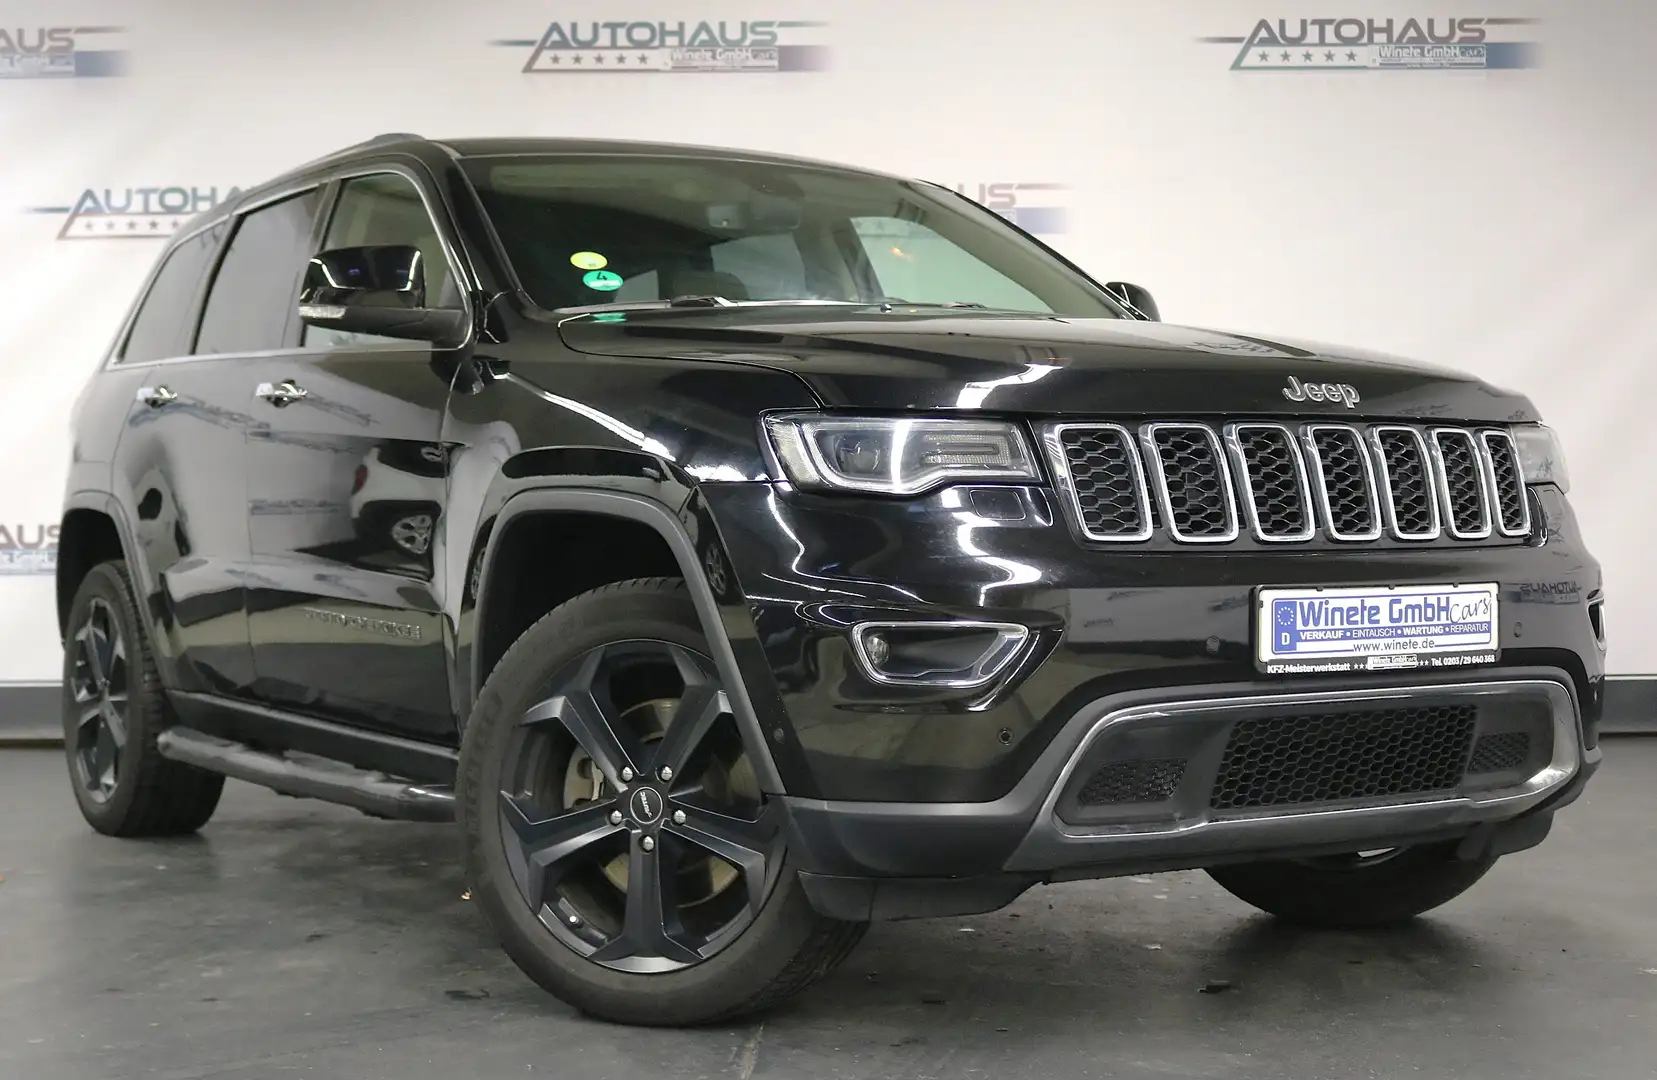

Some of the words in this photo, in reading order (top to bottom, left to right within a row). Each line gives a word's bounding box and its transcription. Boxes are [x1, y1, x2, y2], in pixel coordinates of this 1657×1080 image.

[541, 21, 778, 47] AUTOHAUS
[1247, 18, 1486, 44] AUTOHAUS
[1424, 45, 1460, 58] GmbH
[596, 271, 608, 281] 4
[1281, 375, 1361, 408] Jeep
[1388, 597, 1450, 624] GmbH
[1281, 632, 1290, 646] D
[1300, 630, 1344, 641] VERKAUF
[1352, 627, 1396, 639] EINTAUSCH
[1403, 626, 1444, 637] WARTUNG
[1450, 623, 1489, 635] REPARATUR
[1267, 663, 1351, 674] KFZ-Meisterwerkstatt
